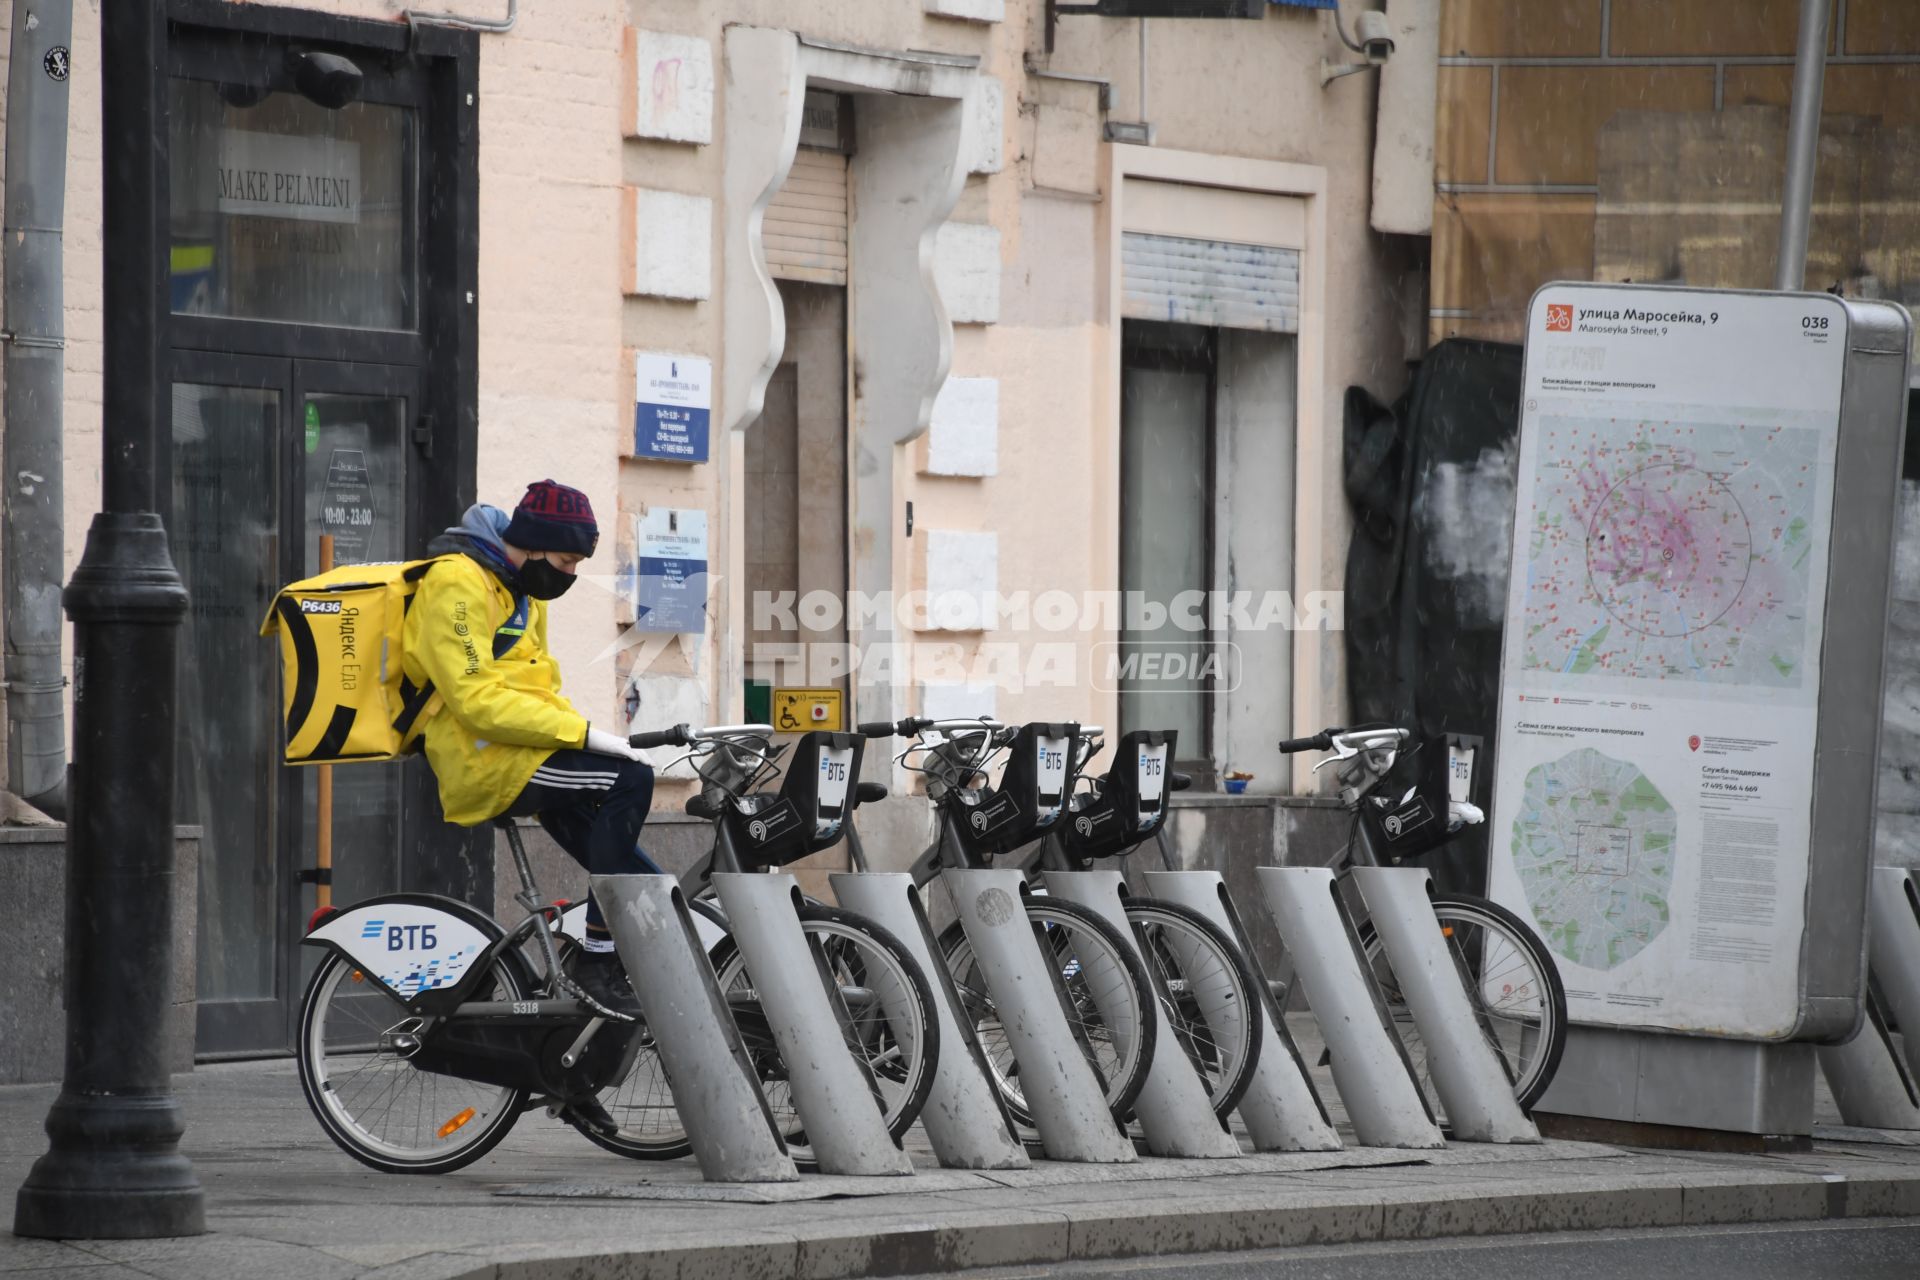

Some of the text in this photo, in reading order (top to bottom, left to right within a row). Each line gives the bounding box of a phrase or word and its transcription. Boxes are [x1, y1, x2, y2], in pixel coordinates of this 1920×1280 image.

[218, 168, 351, 209] MAKE PELMENI
[1578, 309, 1719, 326] улица Маросейка, 9
[1802, 316, 1829, 329] 038
[1578, 324, 1668, 337] Maroseyka Street, 9
[324, 507, 345, 525] 10:00
[350, 508, 372, 526] 23:00
[302, 600, 340, 613] P6436
[339, 607, 361, 691] Яндекс Еда
[1046, 752, 1062, 770] ВТБ
[1146, 758, 1161, 776] ВТБ
[828, 762, 845, 781] ВТБ
[1456, 762, 1468, 779] ВТБ
[1702, 766, 1729, 775] Служба
[387, 924, 438, 952] ВТБ
[513, 1002, 539, 1014] 5318
